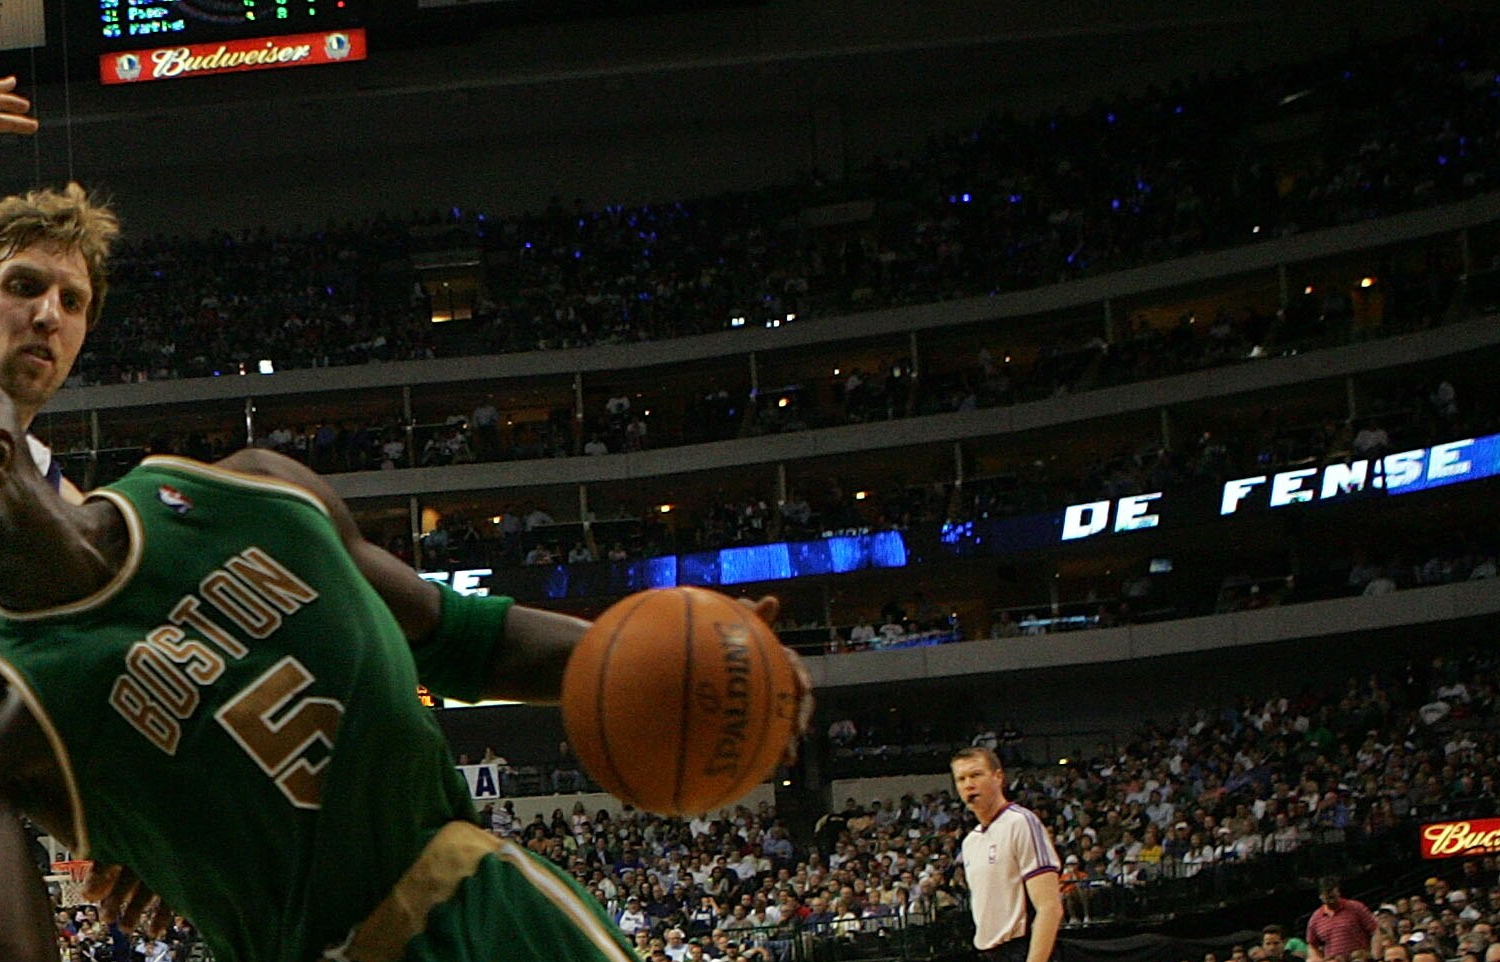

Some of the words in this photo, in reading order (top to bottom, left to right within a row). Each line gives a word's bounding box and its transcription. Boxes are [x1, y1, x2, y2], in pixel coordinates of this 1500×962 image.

[151, 41, 311, 79] Budweiser
[1061, 491, 1164, 541] DE
[1219, 438, 1476, 516] FENSE
[108, 546, 320, 757] BOSTON
[213, 655, 345, 810] 5
